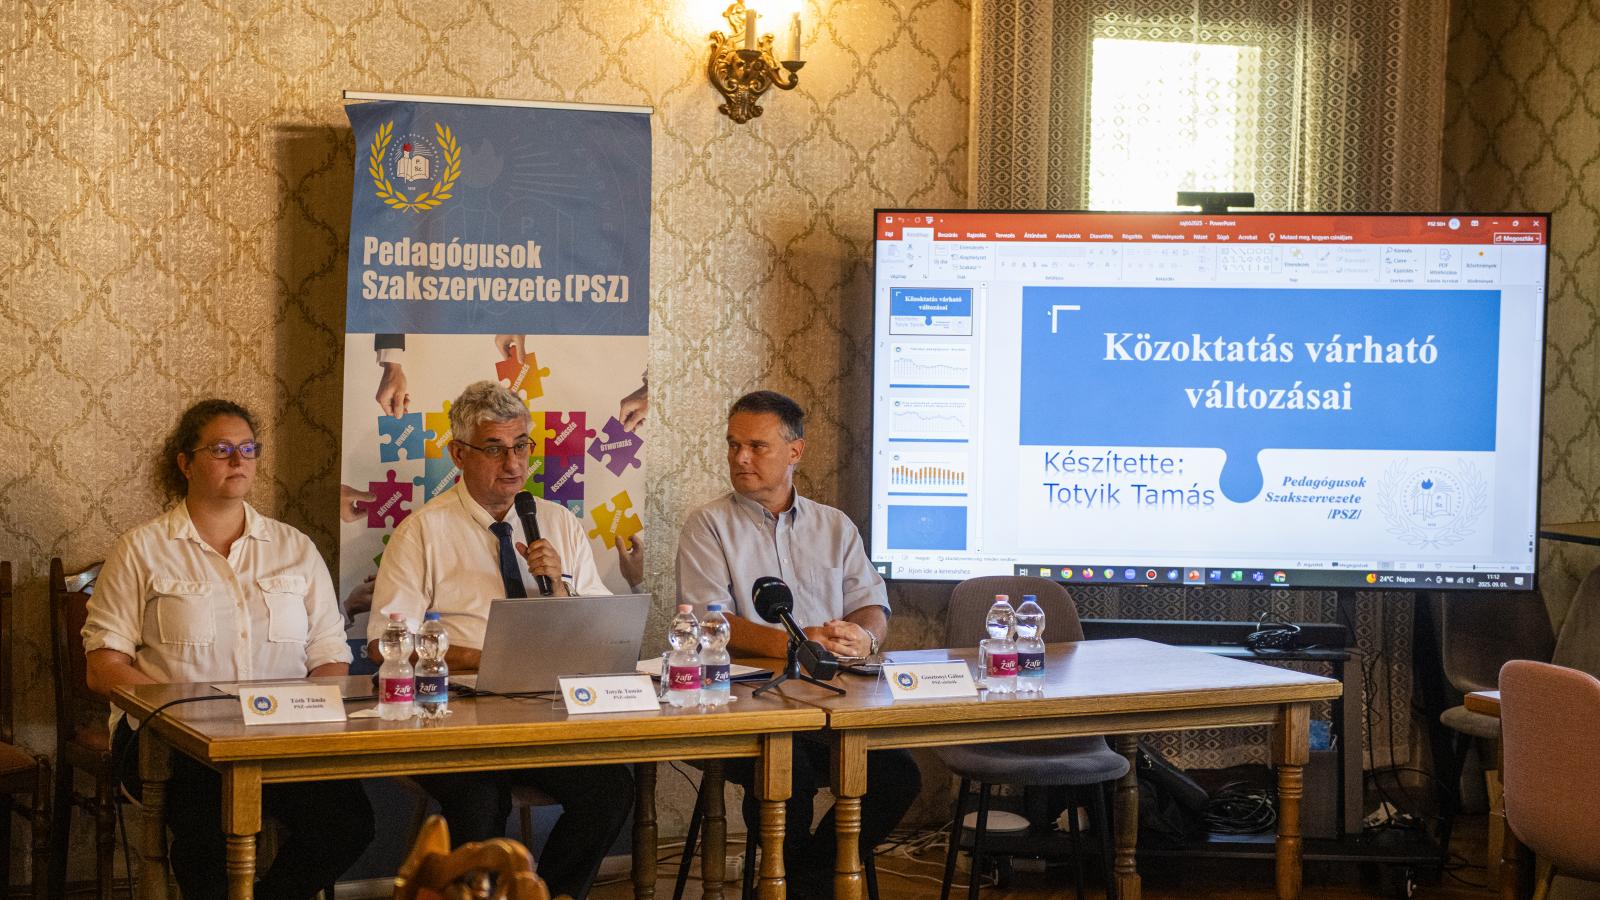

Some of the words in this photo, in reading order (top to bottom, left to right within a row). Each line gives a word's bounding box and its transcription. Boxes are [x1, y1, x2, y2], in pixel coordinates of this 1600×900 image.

[1209, 219, 1236, 227] PowerPoint
[1503, 235, 1533, 243] Megosztás
[363, 235, 543, 271] Pedagógusok
[362, 270, 561, 303] Szakszervezete
[565, 274, 630, 303] (PSZ)
[1103, 332, 1294, 363] Közoktatás
[1304, 333, 1438, 364] várható
[1184, 380, 1352, 410] változásai
[553, 421, 578, 447] KÖZÖSSÉG
[600, 438, 633, 452] ÚTMUTATÁS
[1044, 449, 1184, 475] Készítette:
[549, 463, 579, 494] ÖSSZEFOGÁS
[1282, 475, 1367, 490] Pedagógusok
[376, 490, 403, 517] BÁTORSÁG
[1043, 483, 1120, 508] Totyik
[1131, 483, 1215, 505] Tamás
[1264, 491, 1362, 504] Szakszervezete
[1327, 508, 1362, 521] /PSZ/
[1396, 575, 1416, 584] Napos
